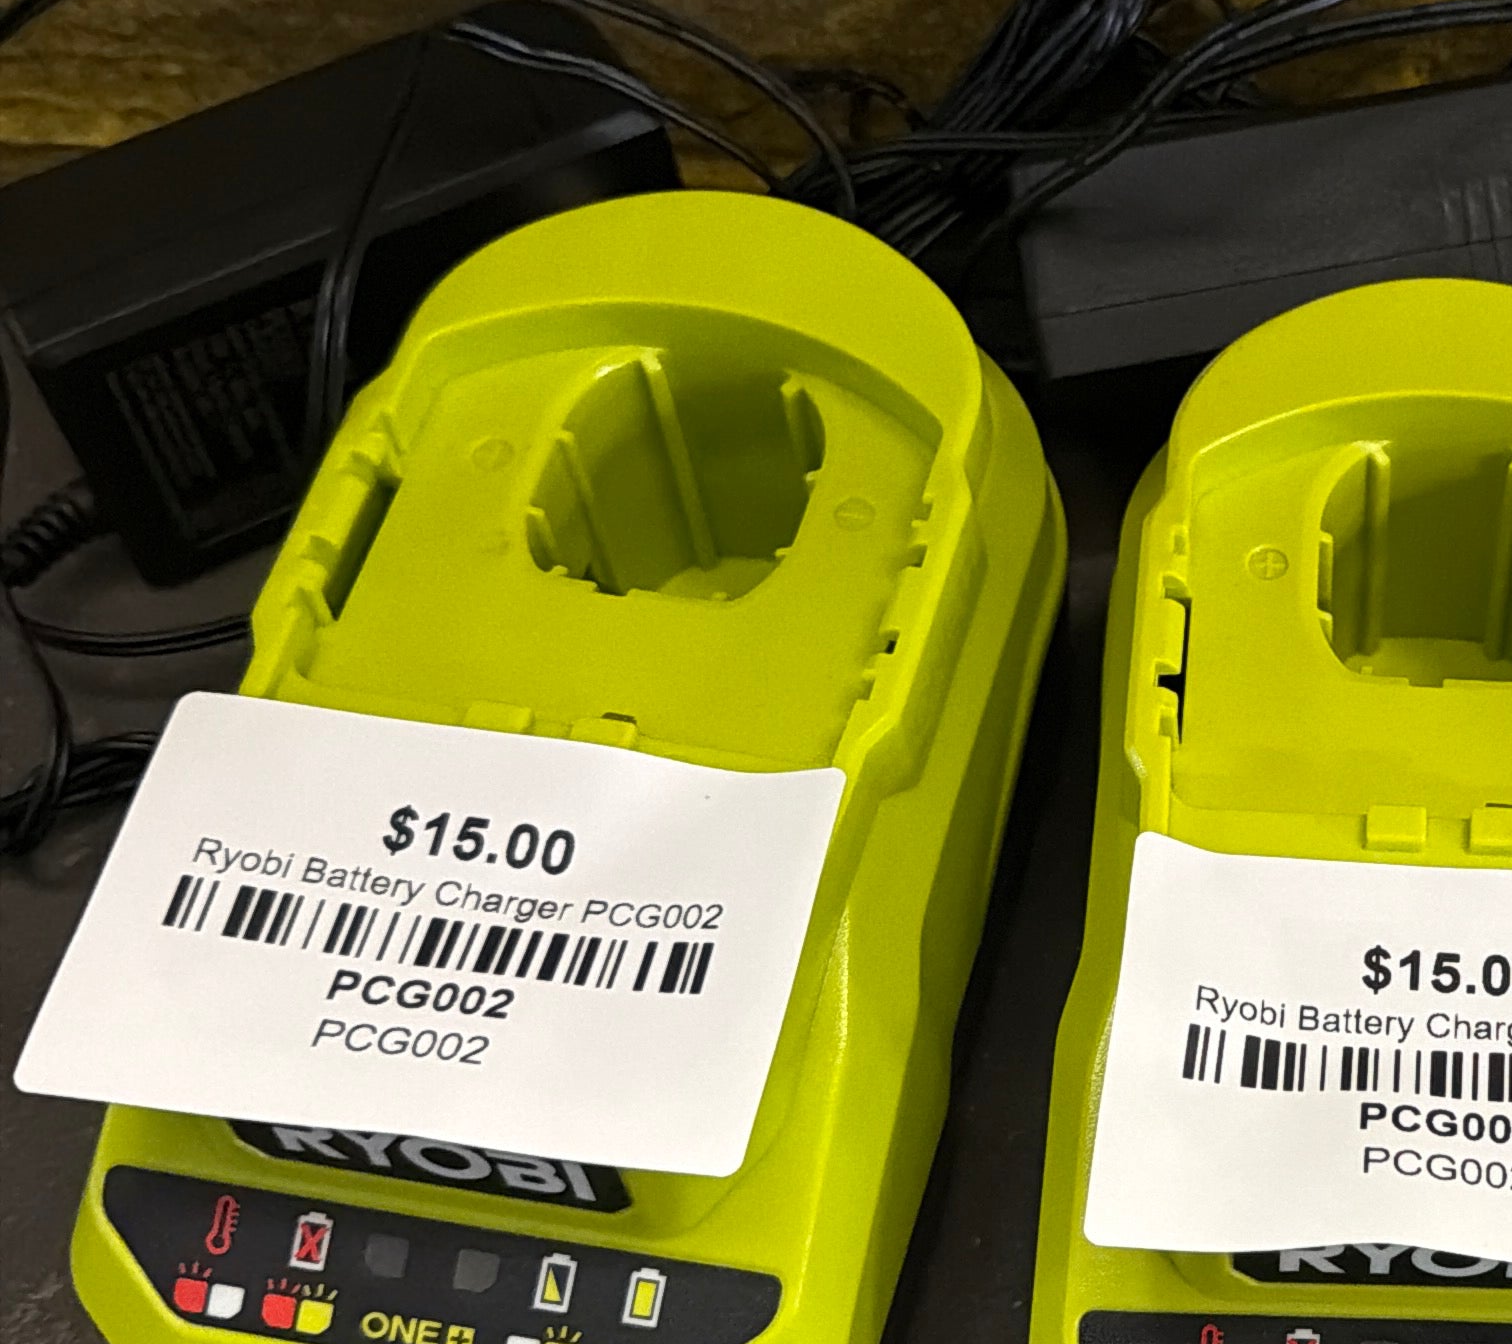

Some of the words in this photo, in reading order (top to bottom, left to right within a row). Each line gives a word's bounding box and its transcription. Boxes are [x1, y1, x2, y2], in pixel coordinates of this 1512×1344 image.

[382, 805, 577, 876] $15.00
[192, 836, 295, 881] Ryobi
[301, 857, 427, 906] Battery
[434, 879, 574, 923] Charger
[582, 900, 723, 929] PCG002
[326, 969, 516, 1020] PCG002
[1195, 985, 1287, 1029] Ryobi
[1299, 1005, 1414, 1043] Battery
[311, 1018, 490, 1066] PCG002
[271, 1126, 597, 1202] RYOBI
